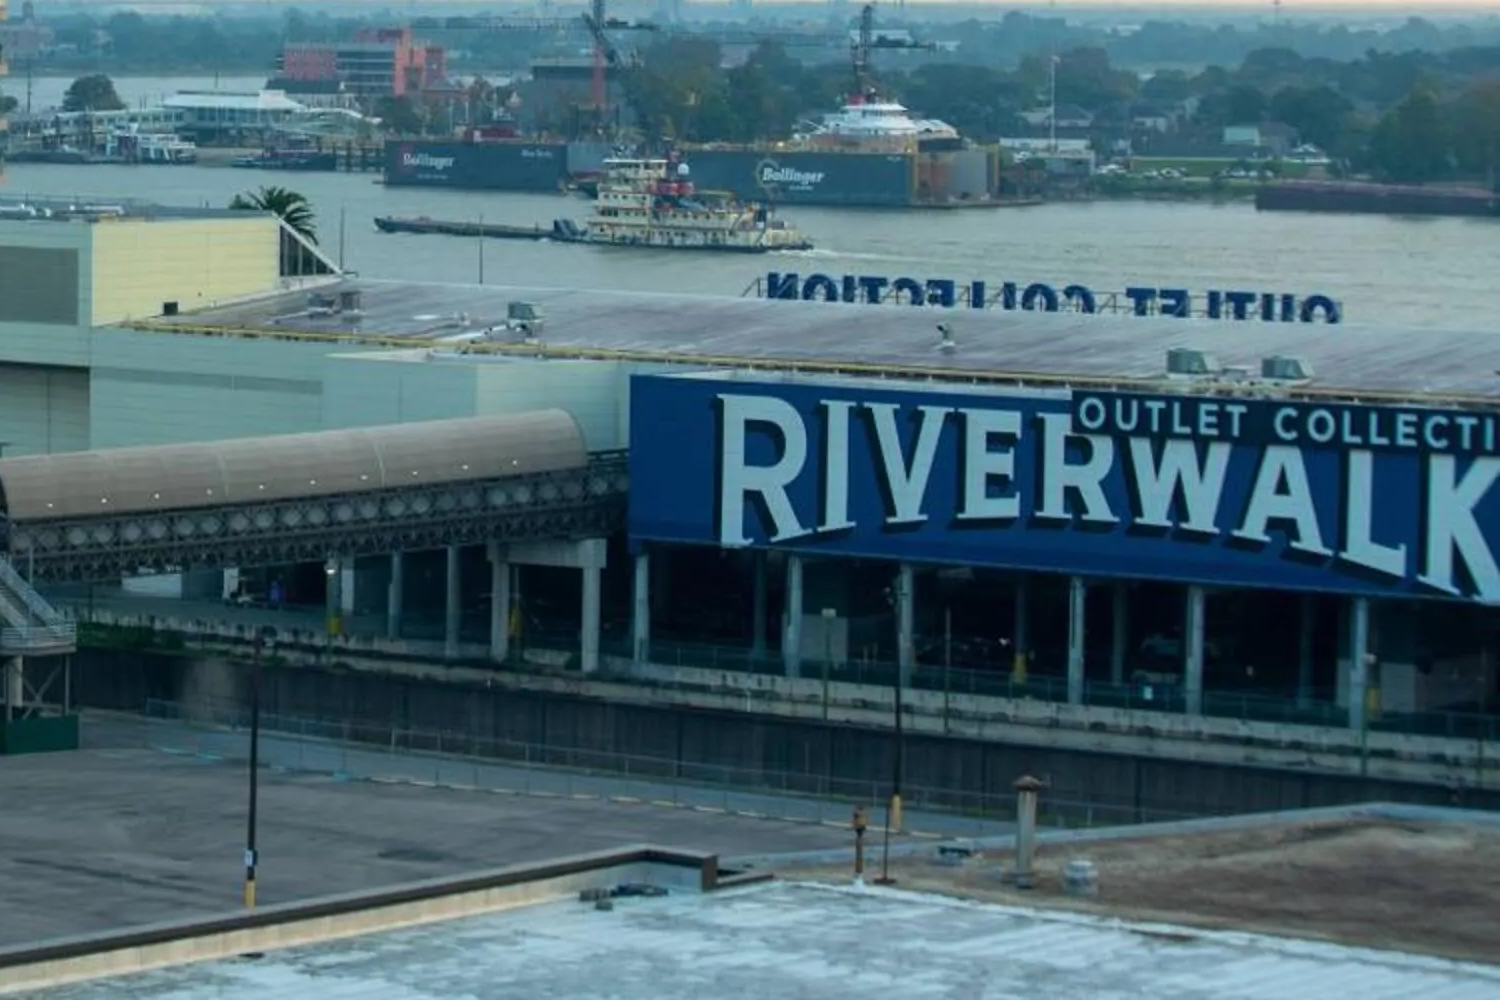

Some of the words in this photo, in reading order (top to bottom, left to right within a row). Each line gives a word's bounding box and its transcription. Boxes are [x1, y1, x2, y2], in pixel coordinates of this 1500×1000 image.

[762, 167, 825, 185] Bollinger
[1079, 398, 1248, 437] OUTLET
[1273, 407, 1496, 452] COLLECTI
[717, 393, 1500, 606] RIVERWALK
